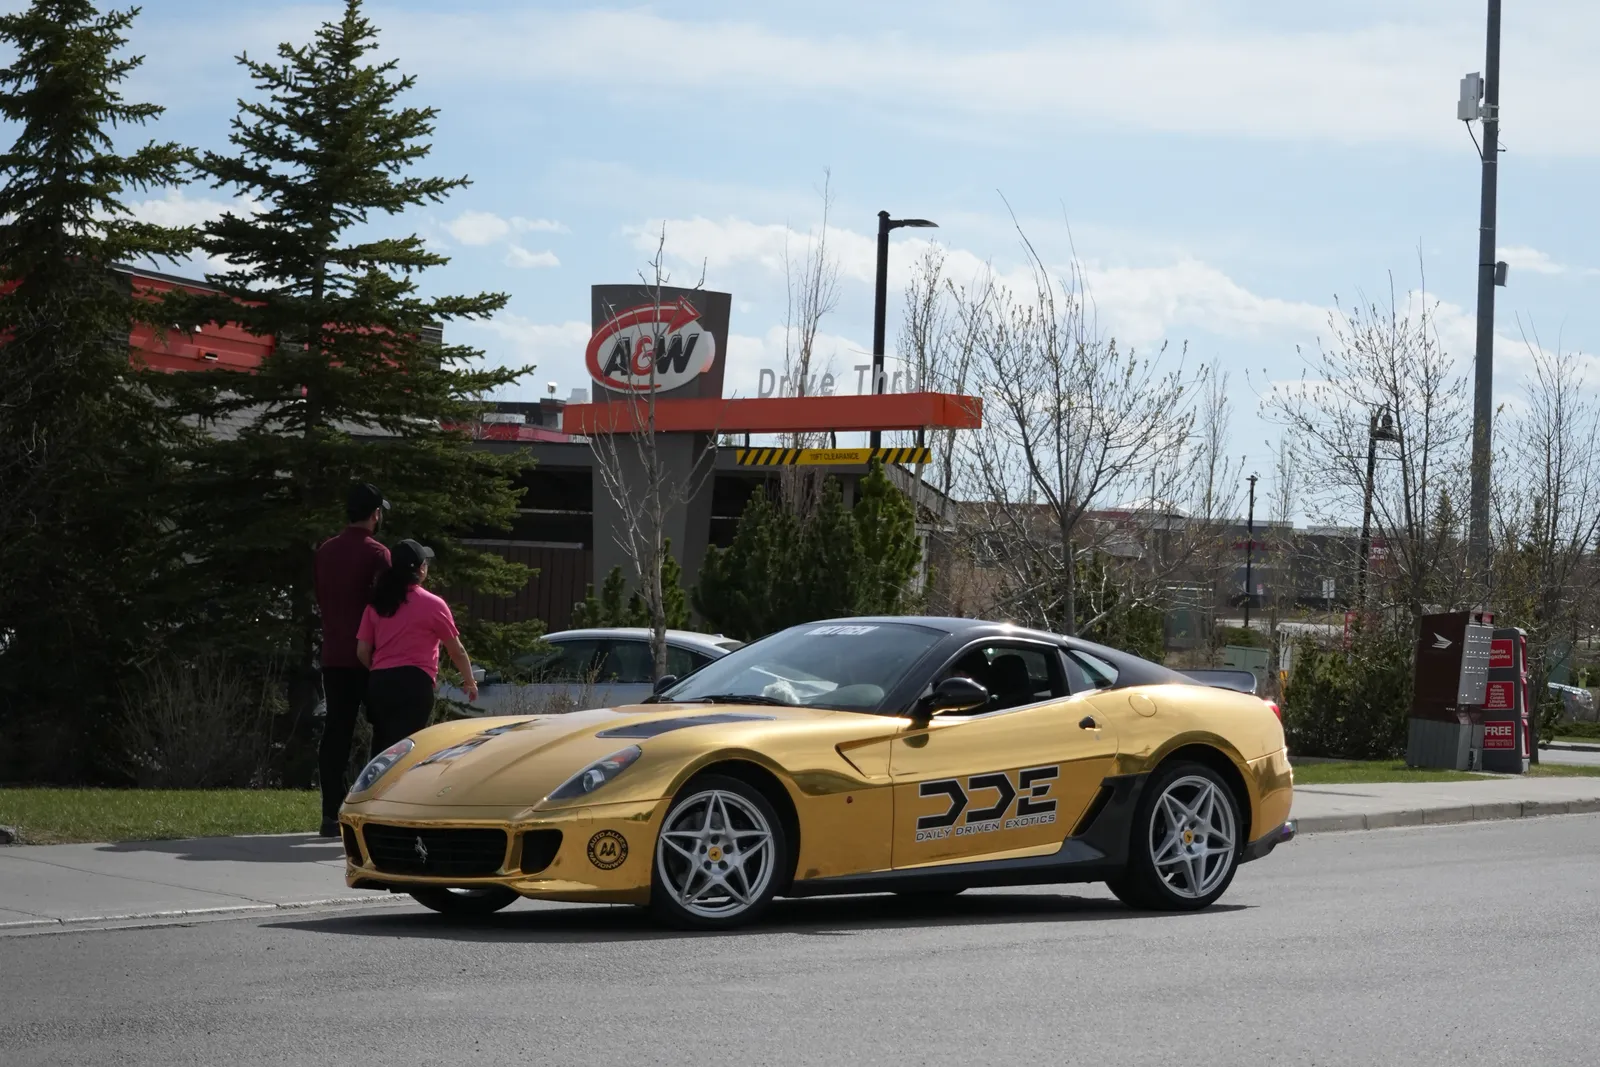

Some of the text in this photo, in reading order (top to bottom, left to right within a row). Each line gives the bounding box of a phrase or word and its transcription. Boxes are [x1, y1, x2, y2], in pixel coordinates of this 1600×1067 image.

[603, 333, 700, 377] A&W
[758, 364, 921, 398] Drive Thru
[823, 452, 860, 461] CLEARANCE
[1484, 726, 1512, 736] FREE
[915, 813, 1056, 842] DAILY DRIVEN EXOTICS
[589, 831, 627, 849] AUTO ALLIES
[588, 851, 627, 869] NATIONWIDE
